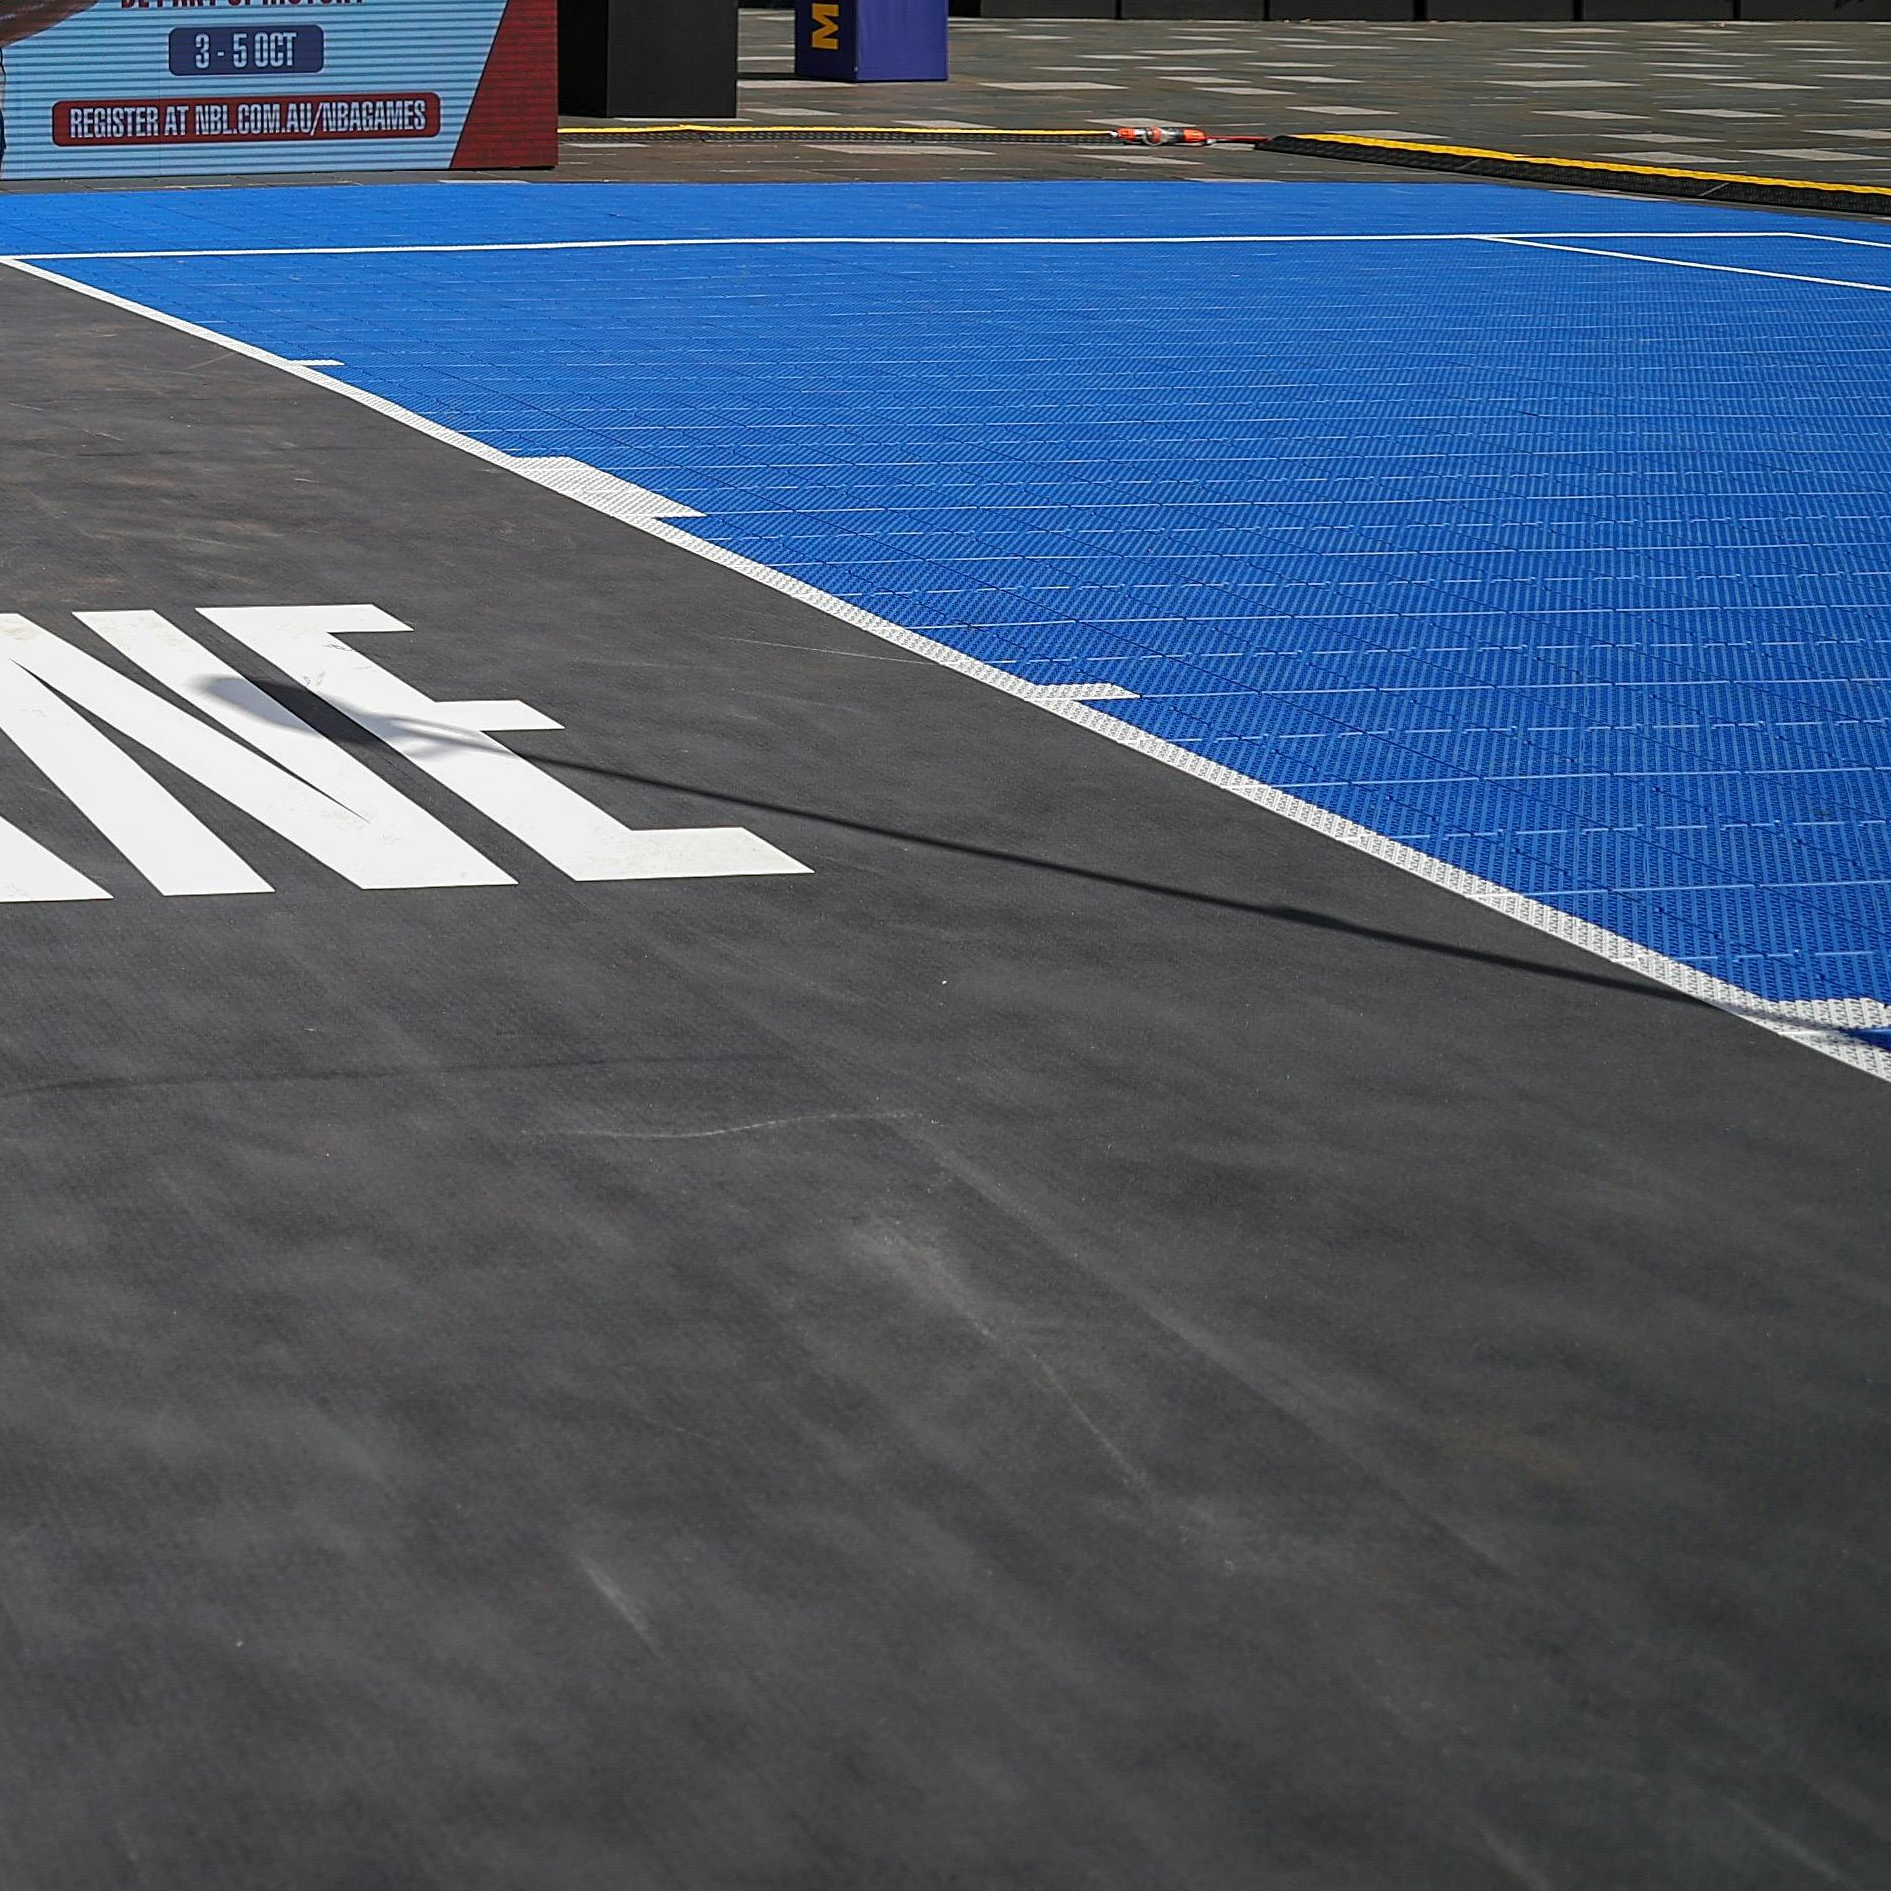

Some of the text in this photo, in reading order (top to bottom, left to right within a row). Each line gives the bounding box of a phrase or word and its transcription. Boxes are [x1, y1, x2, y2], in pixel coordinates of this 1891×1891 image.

[194, 33, 210, 70] 3
[233, 32, 248, 69] 5
[254, 31, 298, 68] OCT
[70, 99, 426, 139] REGISTER AT NBL.COM.AU/NBAGAMES
